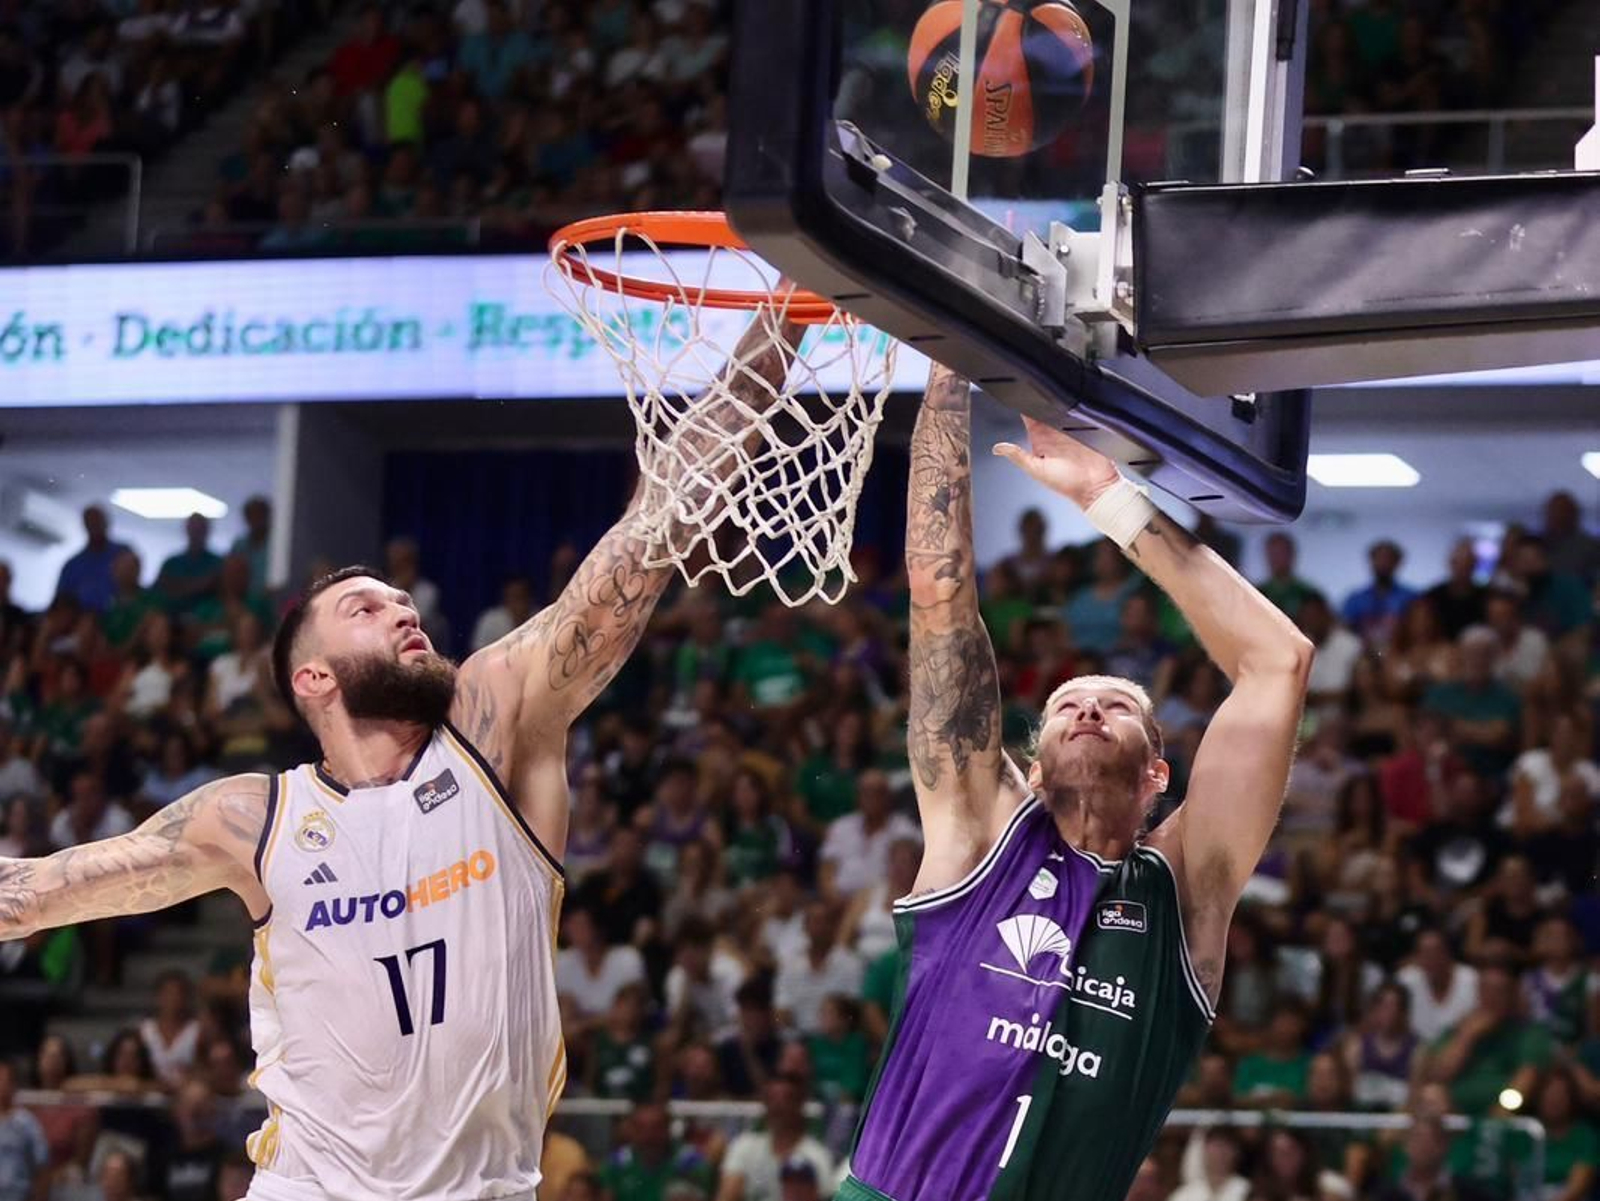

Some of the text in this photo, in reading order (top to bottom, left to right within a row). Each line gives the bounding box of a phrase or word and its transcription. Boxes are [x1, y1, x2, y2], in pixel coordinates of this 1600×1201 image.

[984, 80, 1013, 155] SPAL
[112, 307, 421, 355] Dedicación
[305, 849, 495, 931] AUTOHERO
[373, 938, 447, 1036] 17
[986, 1012, 1102, 1078] málaga
[999, 1094, 1032, 1168] 1
